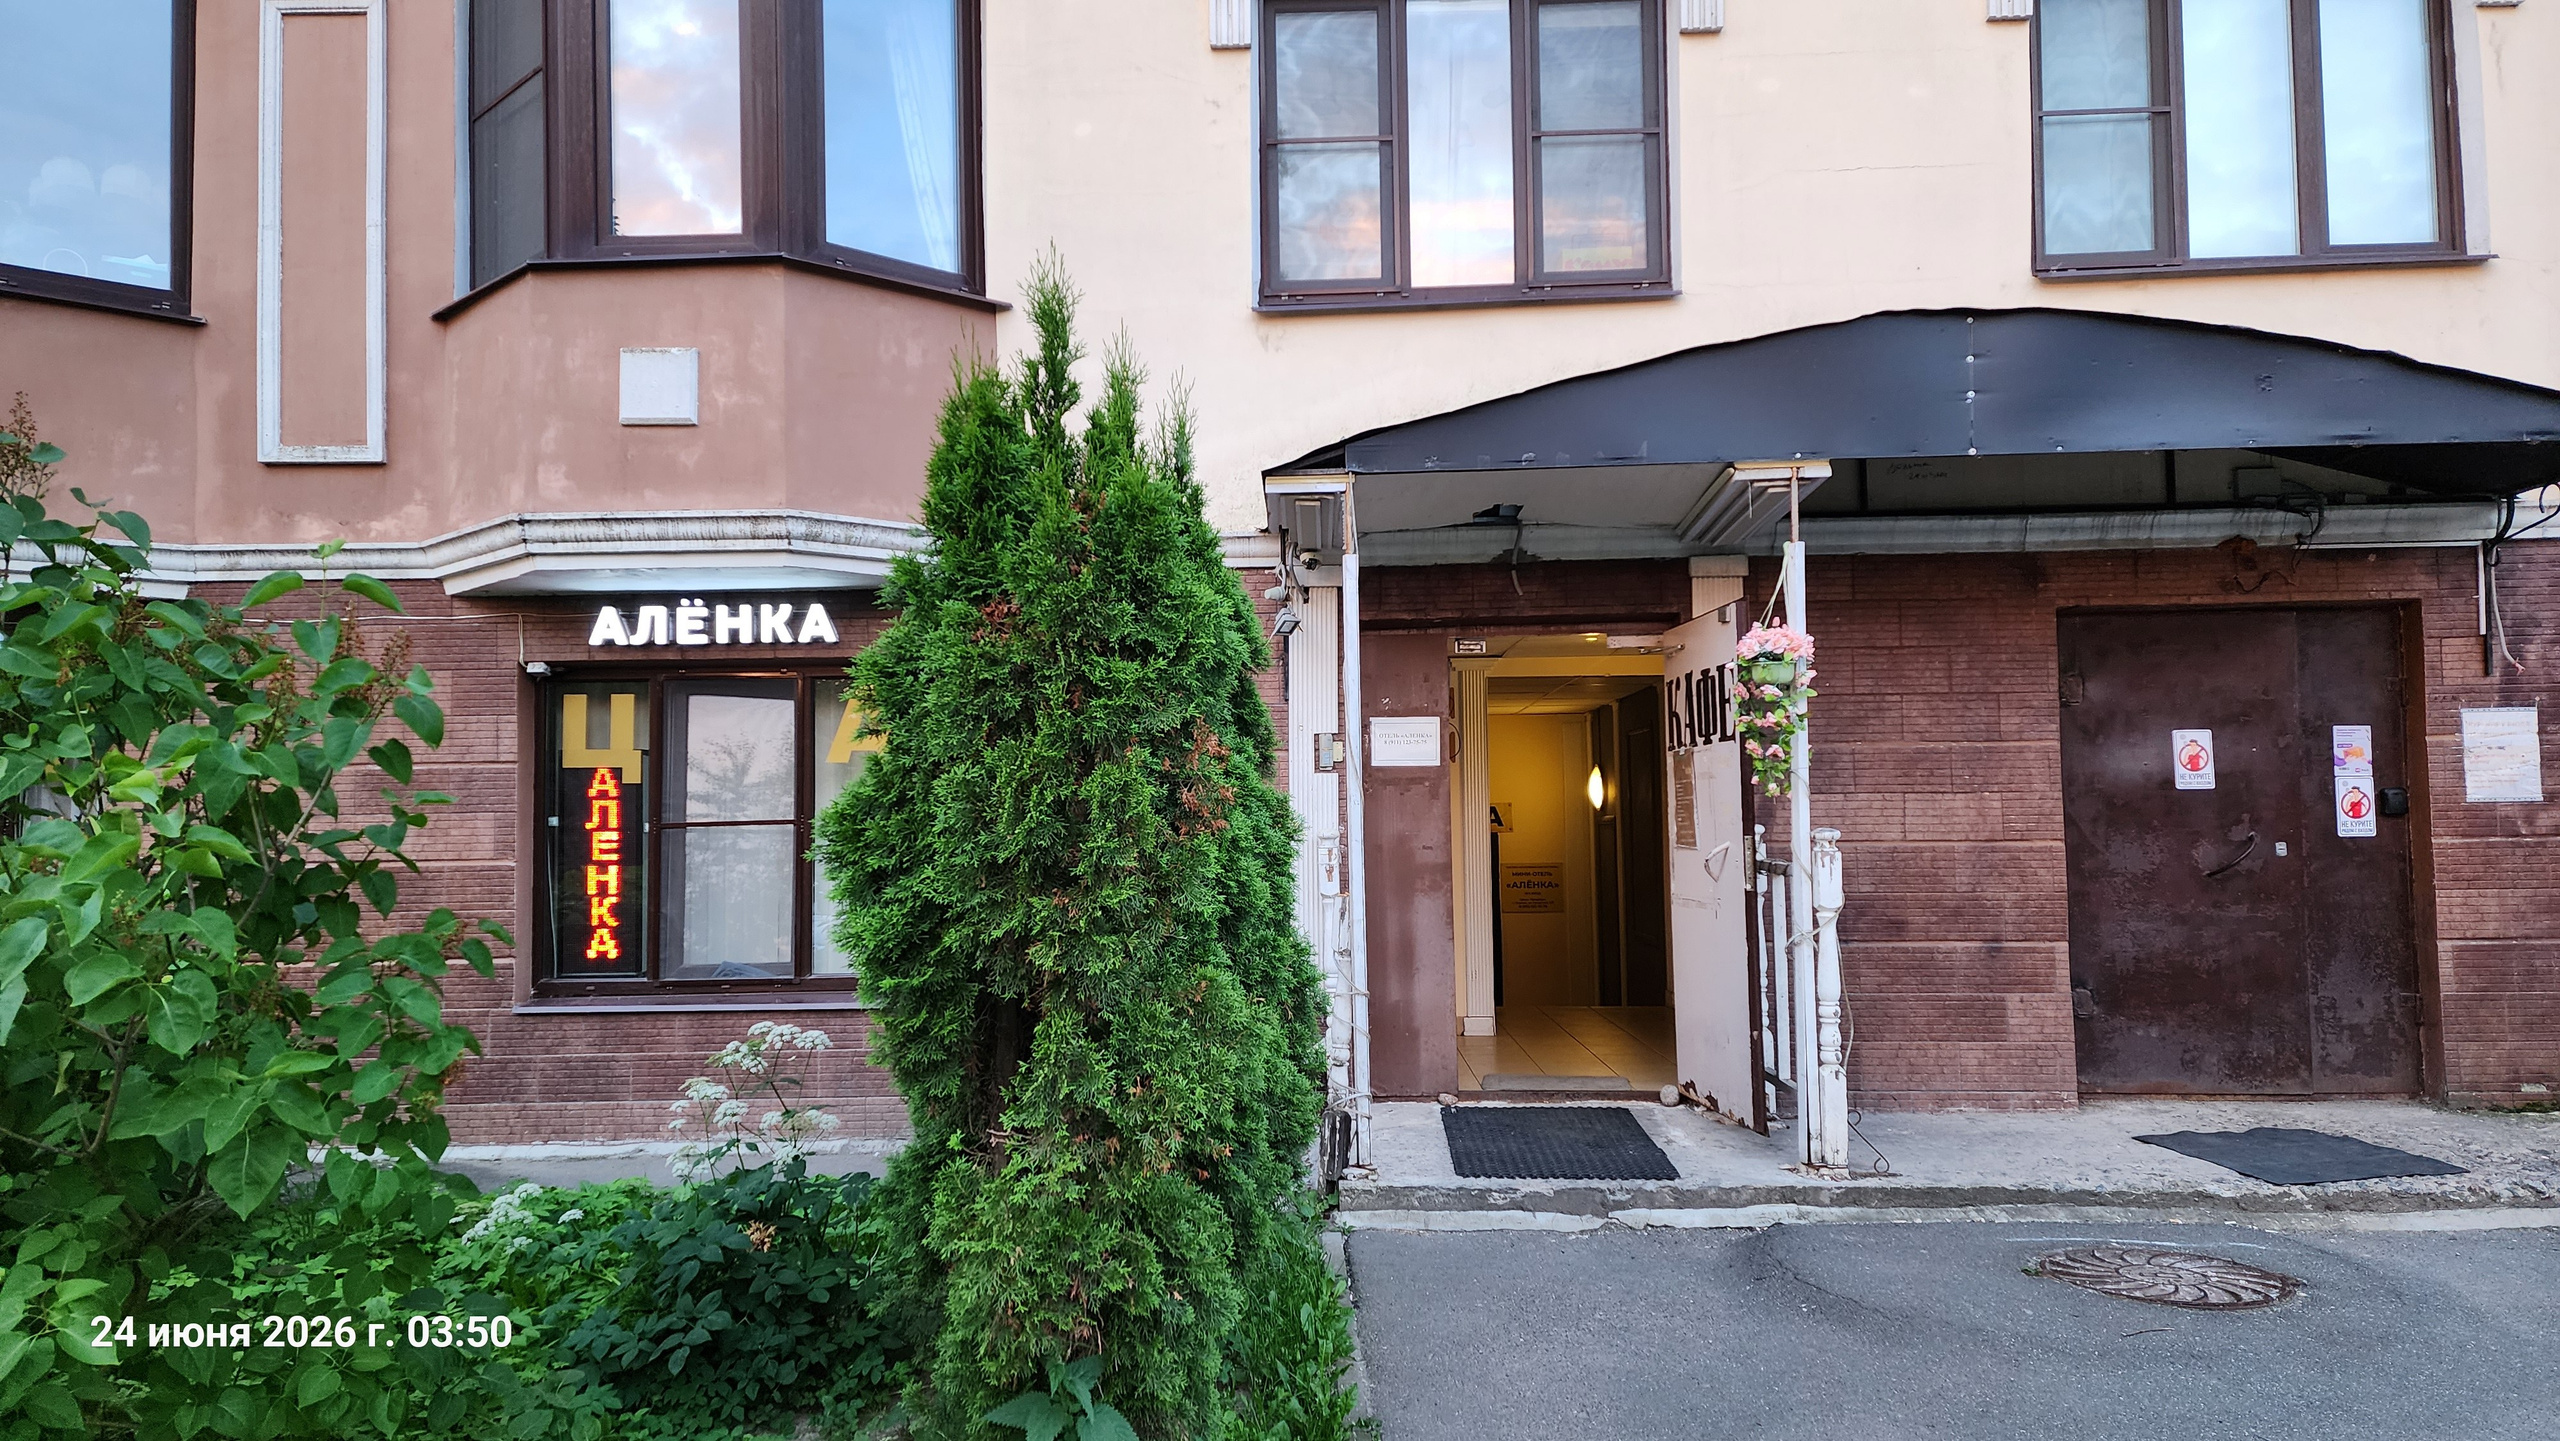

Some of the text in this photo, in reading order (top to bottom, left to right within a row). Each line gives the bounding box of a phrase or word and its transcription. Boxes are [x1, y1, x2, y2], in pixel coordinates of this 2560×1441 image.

[588, 598, 840, 646] АЛЁНКА
[562, 693, 642, 784] Ц
[1666, 658, 1736, 752] КАФЕ
[2341, 820, 2349, 828] НЕ
[585, 767, 622, 960] АЛЕНКА
[1506, 880, 1559, 889] «АЛЁНКА»
